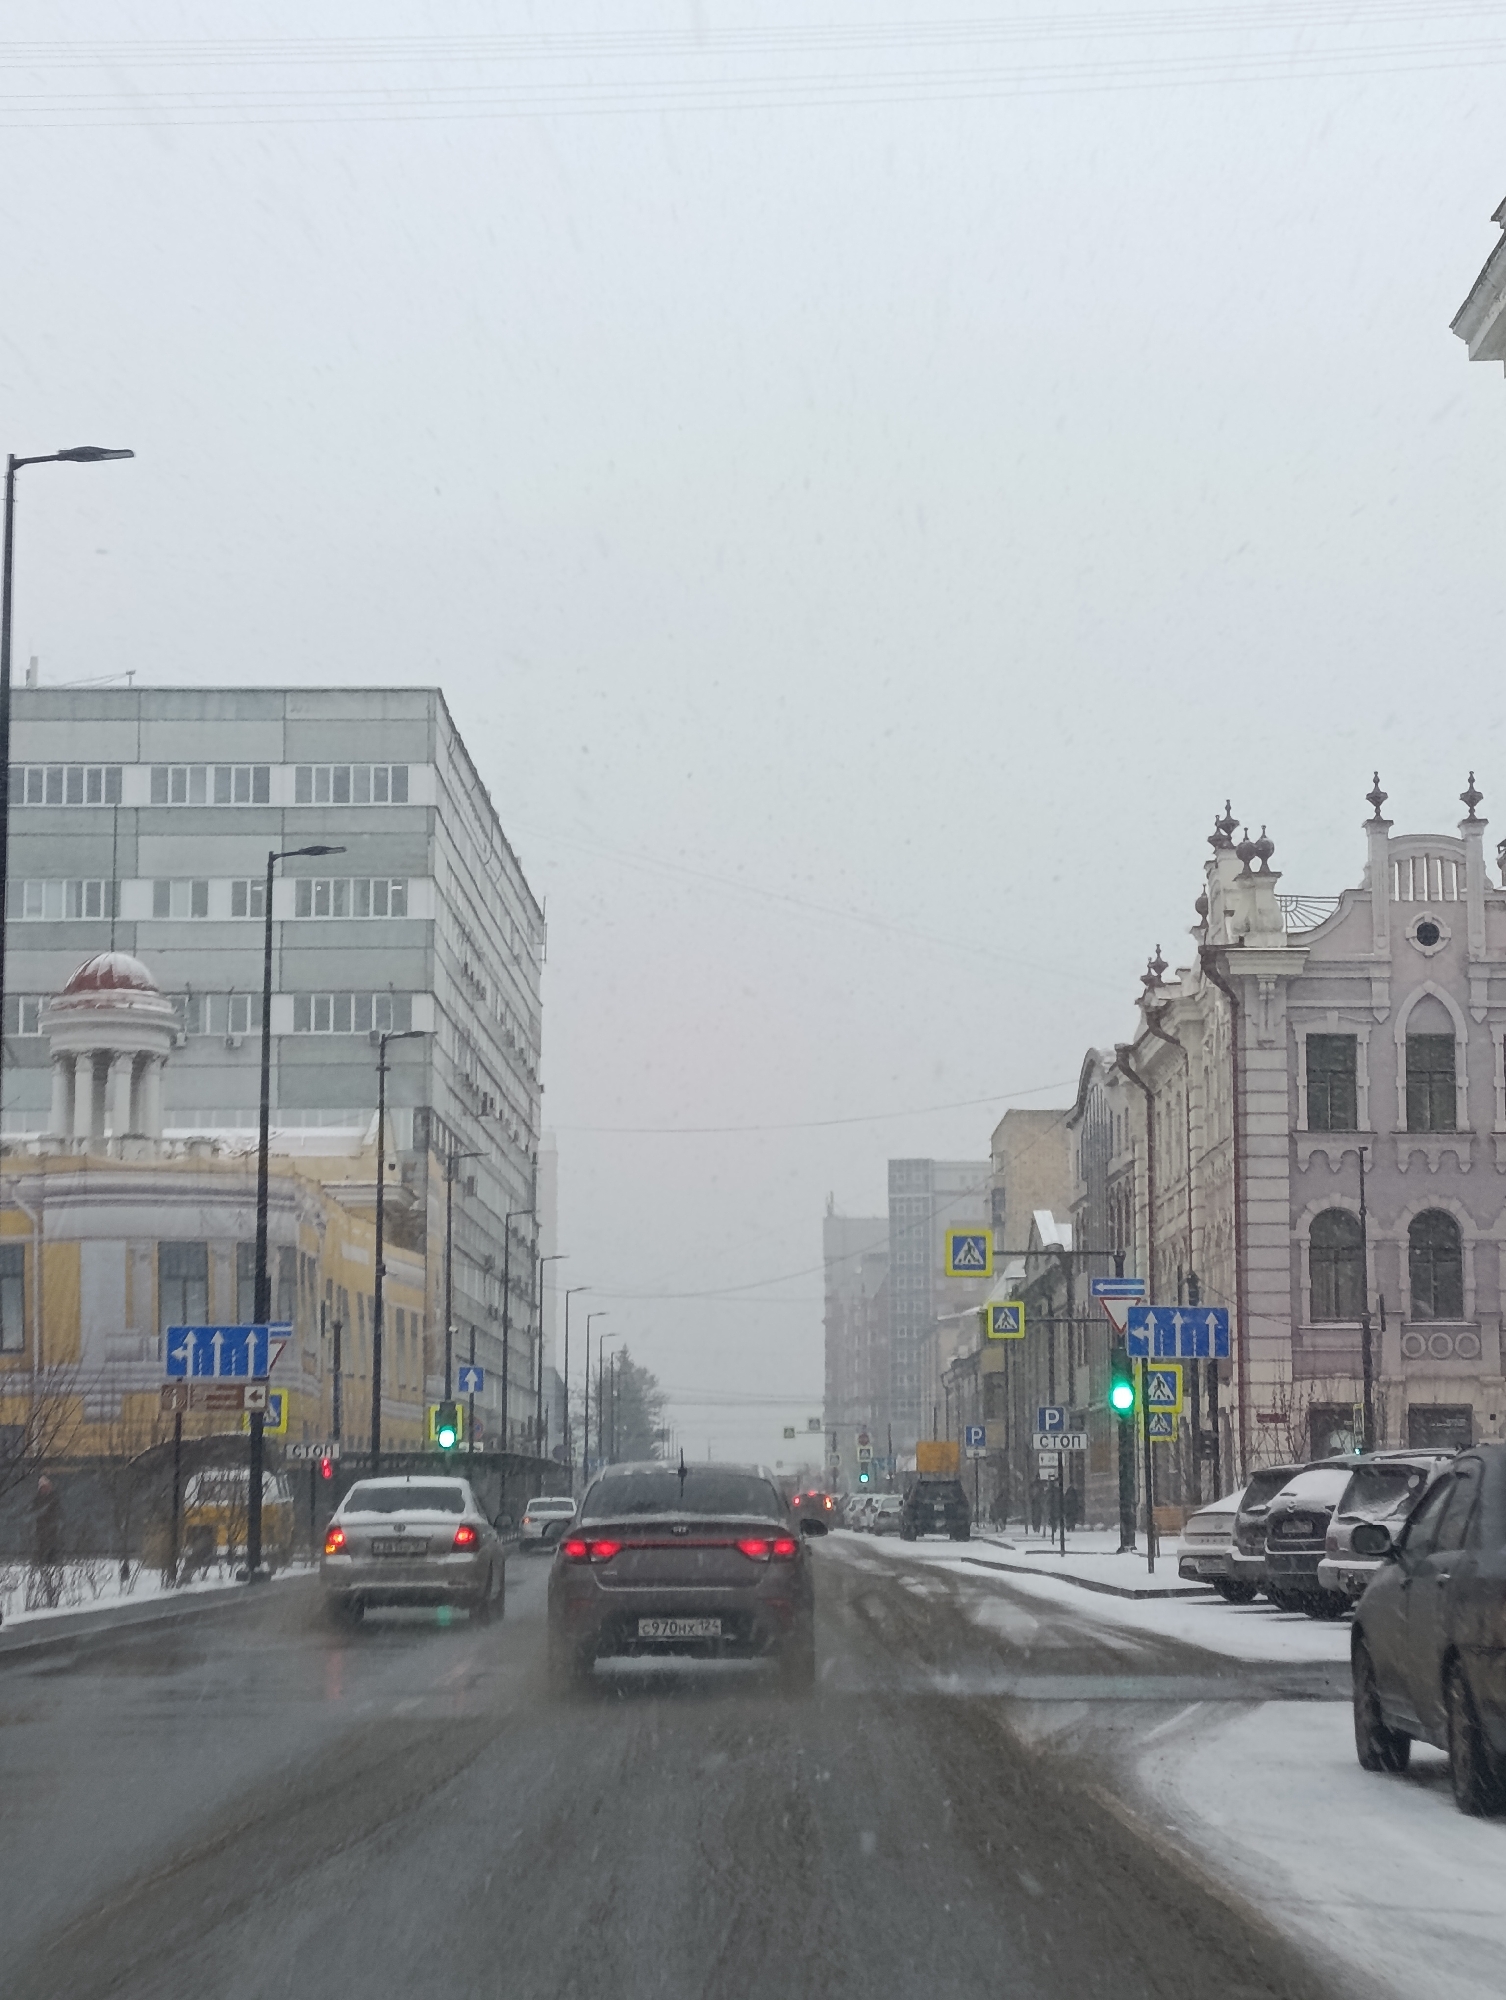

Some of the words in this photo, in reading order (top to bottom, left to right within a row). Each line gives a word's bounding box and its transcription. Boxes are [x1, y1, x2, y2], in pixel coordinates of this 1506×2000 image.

[1045, 1409, 1060, 1431] P
[971, 1427, 983, 1445] P
[1040, 1435, 1081, 1449] СТОП
[292, 1444, 334, 1458] СТОП
